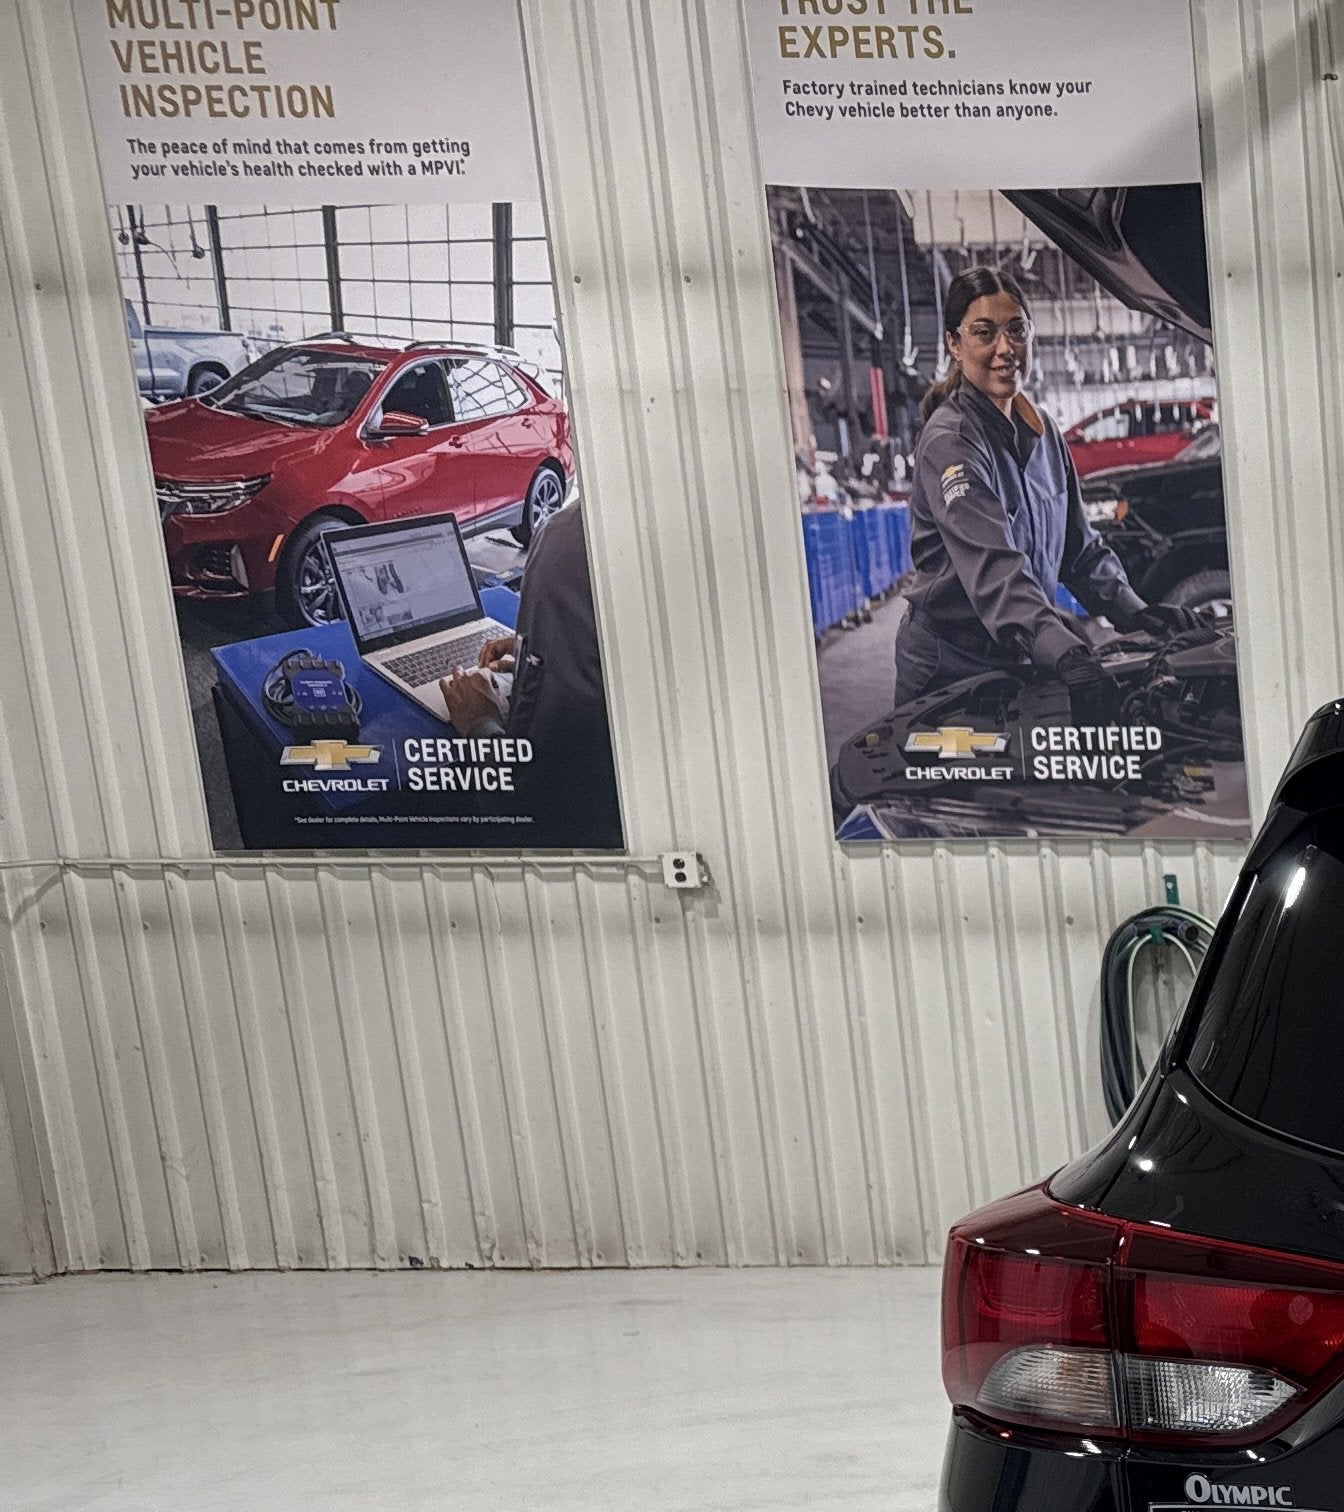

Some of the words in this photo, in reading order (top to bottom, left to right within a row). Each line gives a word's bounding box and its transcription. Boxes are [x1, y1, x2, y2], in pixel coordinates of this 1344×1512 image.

[106, 0, 340, 31] MULTI-POINT
[778, 25, 956, 59] EXPERTS.
[110, 40, 267, 74] VEHICLE
[783, 79, 845, 98] Factory
[849, 79, 908, 97] trained
[912, 79, 1005, 97] technicians
[1009, 79, 1051, 96] know
[1055, 80, 1093, 97] your
[119, 84, 336, 119] INSPECTION
[785, 101, 835, 120] Chevy
[839, 102, 896, 118] vehicle
[900, 102, 950, 118] better
[954, 102, 992, 118] than
[996, 104, 1059, 121] anyone.
[127, 138, 156, 155] The
[161, 141, 208, 158] peace
[212, 138, 229, 155] of
[233, 138, 272, 155] mind
[276, 139, 310, 155] that
[314, 142, 365, 155] comes
[369, 138, 408, 154] from
[412, 137, 471, 158] getting
[131, 162, 167, 180] your
[170, 159, 239, 177] vehicle's
[243, 160, 294, 177] health
[298, 160, 364, 177] checked
[367, 160, 403, 176] with
[408, 164, 417, 176] a
[403, 738, 533, 763] CERTIFIED
[1031, 726, 1162, 751] CERTIFIED
[407, 767, 515, 791] SERVICE
[905, 766, 1015, 780] CHEVROLET
[1033, 755, 1143, 780] SERVICE
[283, 778, 390, 792] CHEVROLET
